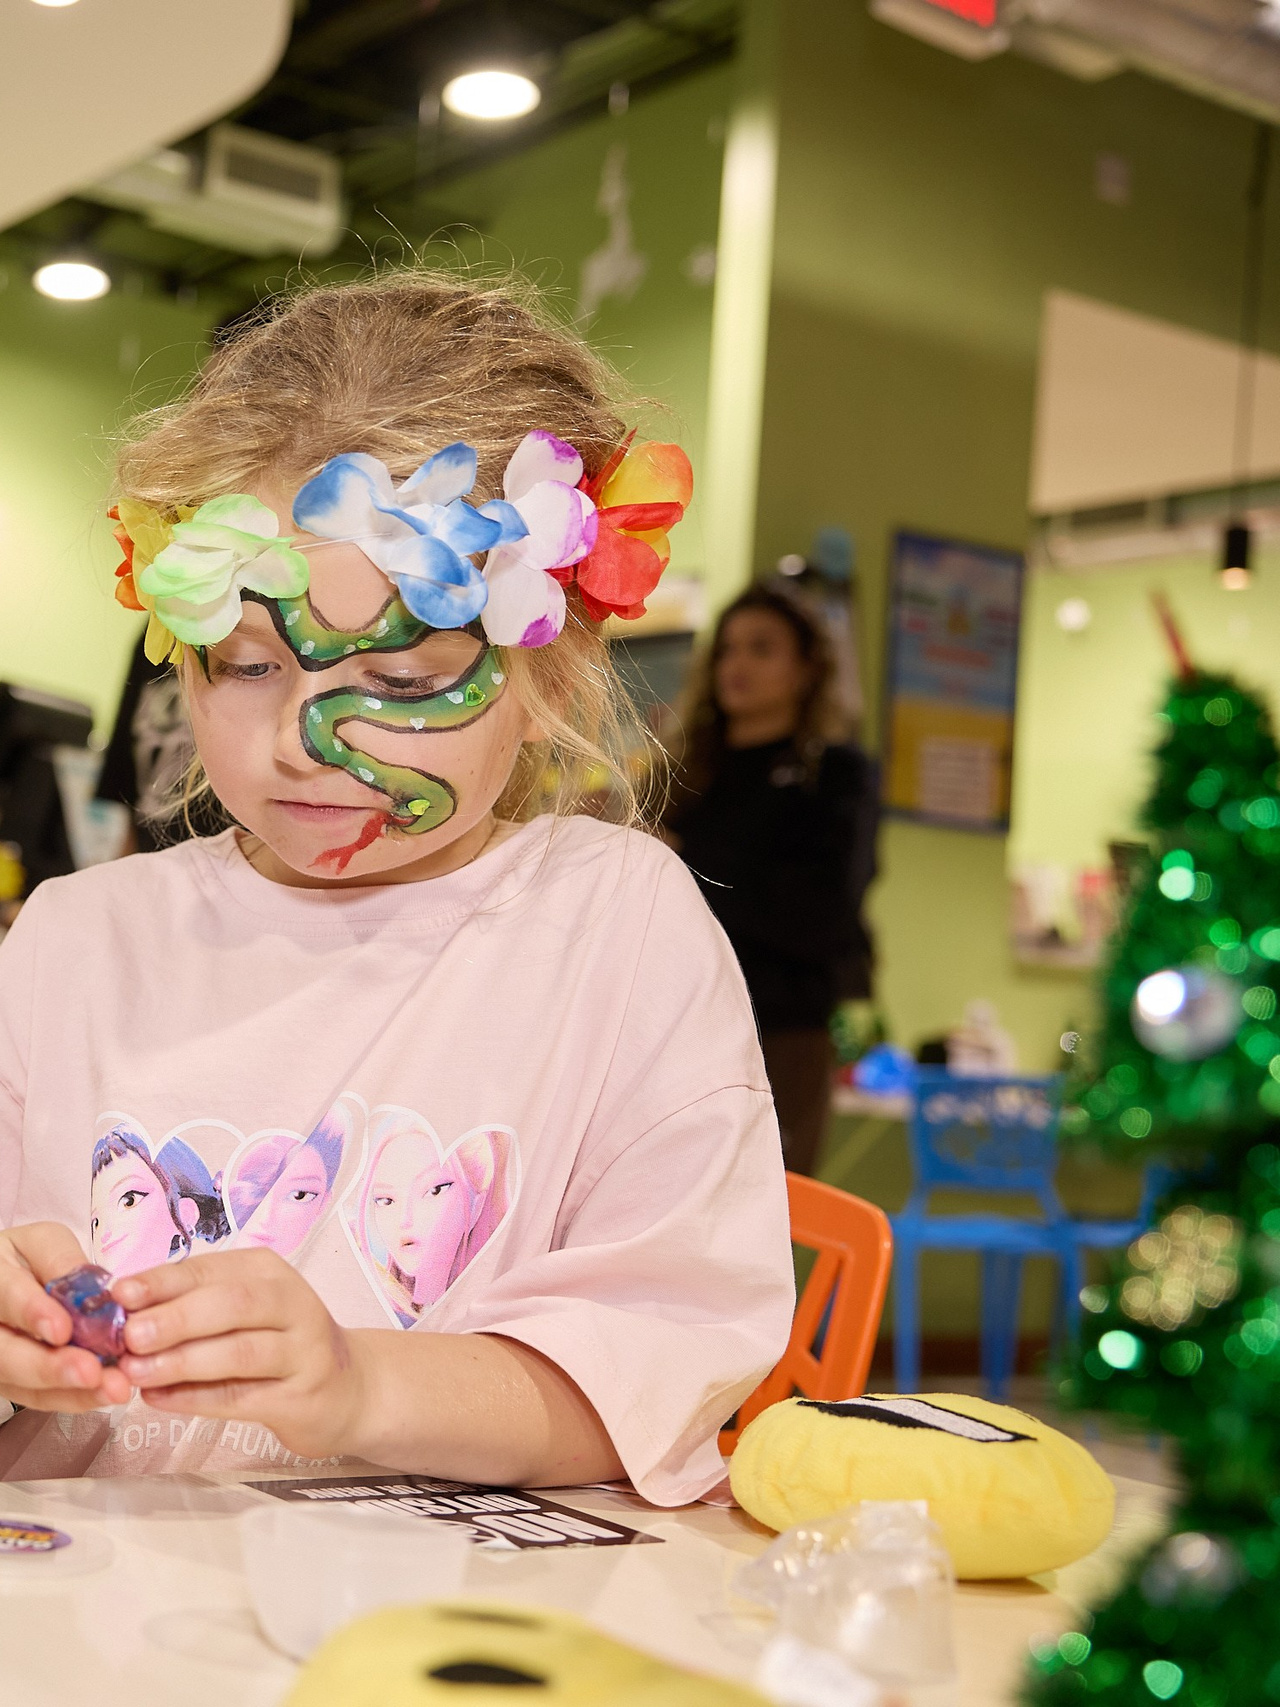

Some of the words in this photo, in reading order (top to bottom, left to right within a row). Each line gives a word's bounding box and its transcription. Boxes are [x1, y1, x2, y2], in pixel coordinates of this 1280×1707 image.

[291, 1485, 386, 1500] DRINK
[375, 1484, 424, 1496] OR
[471, 1511, 625, 1543] NO
